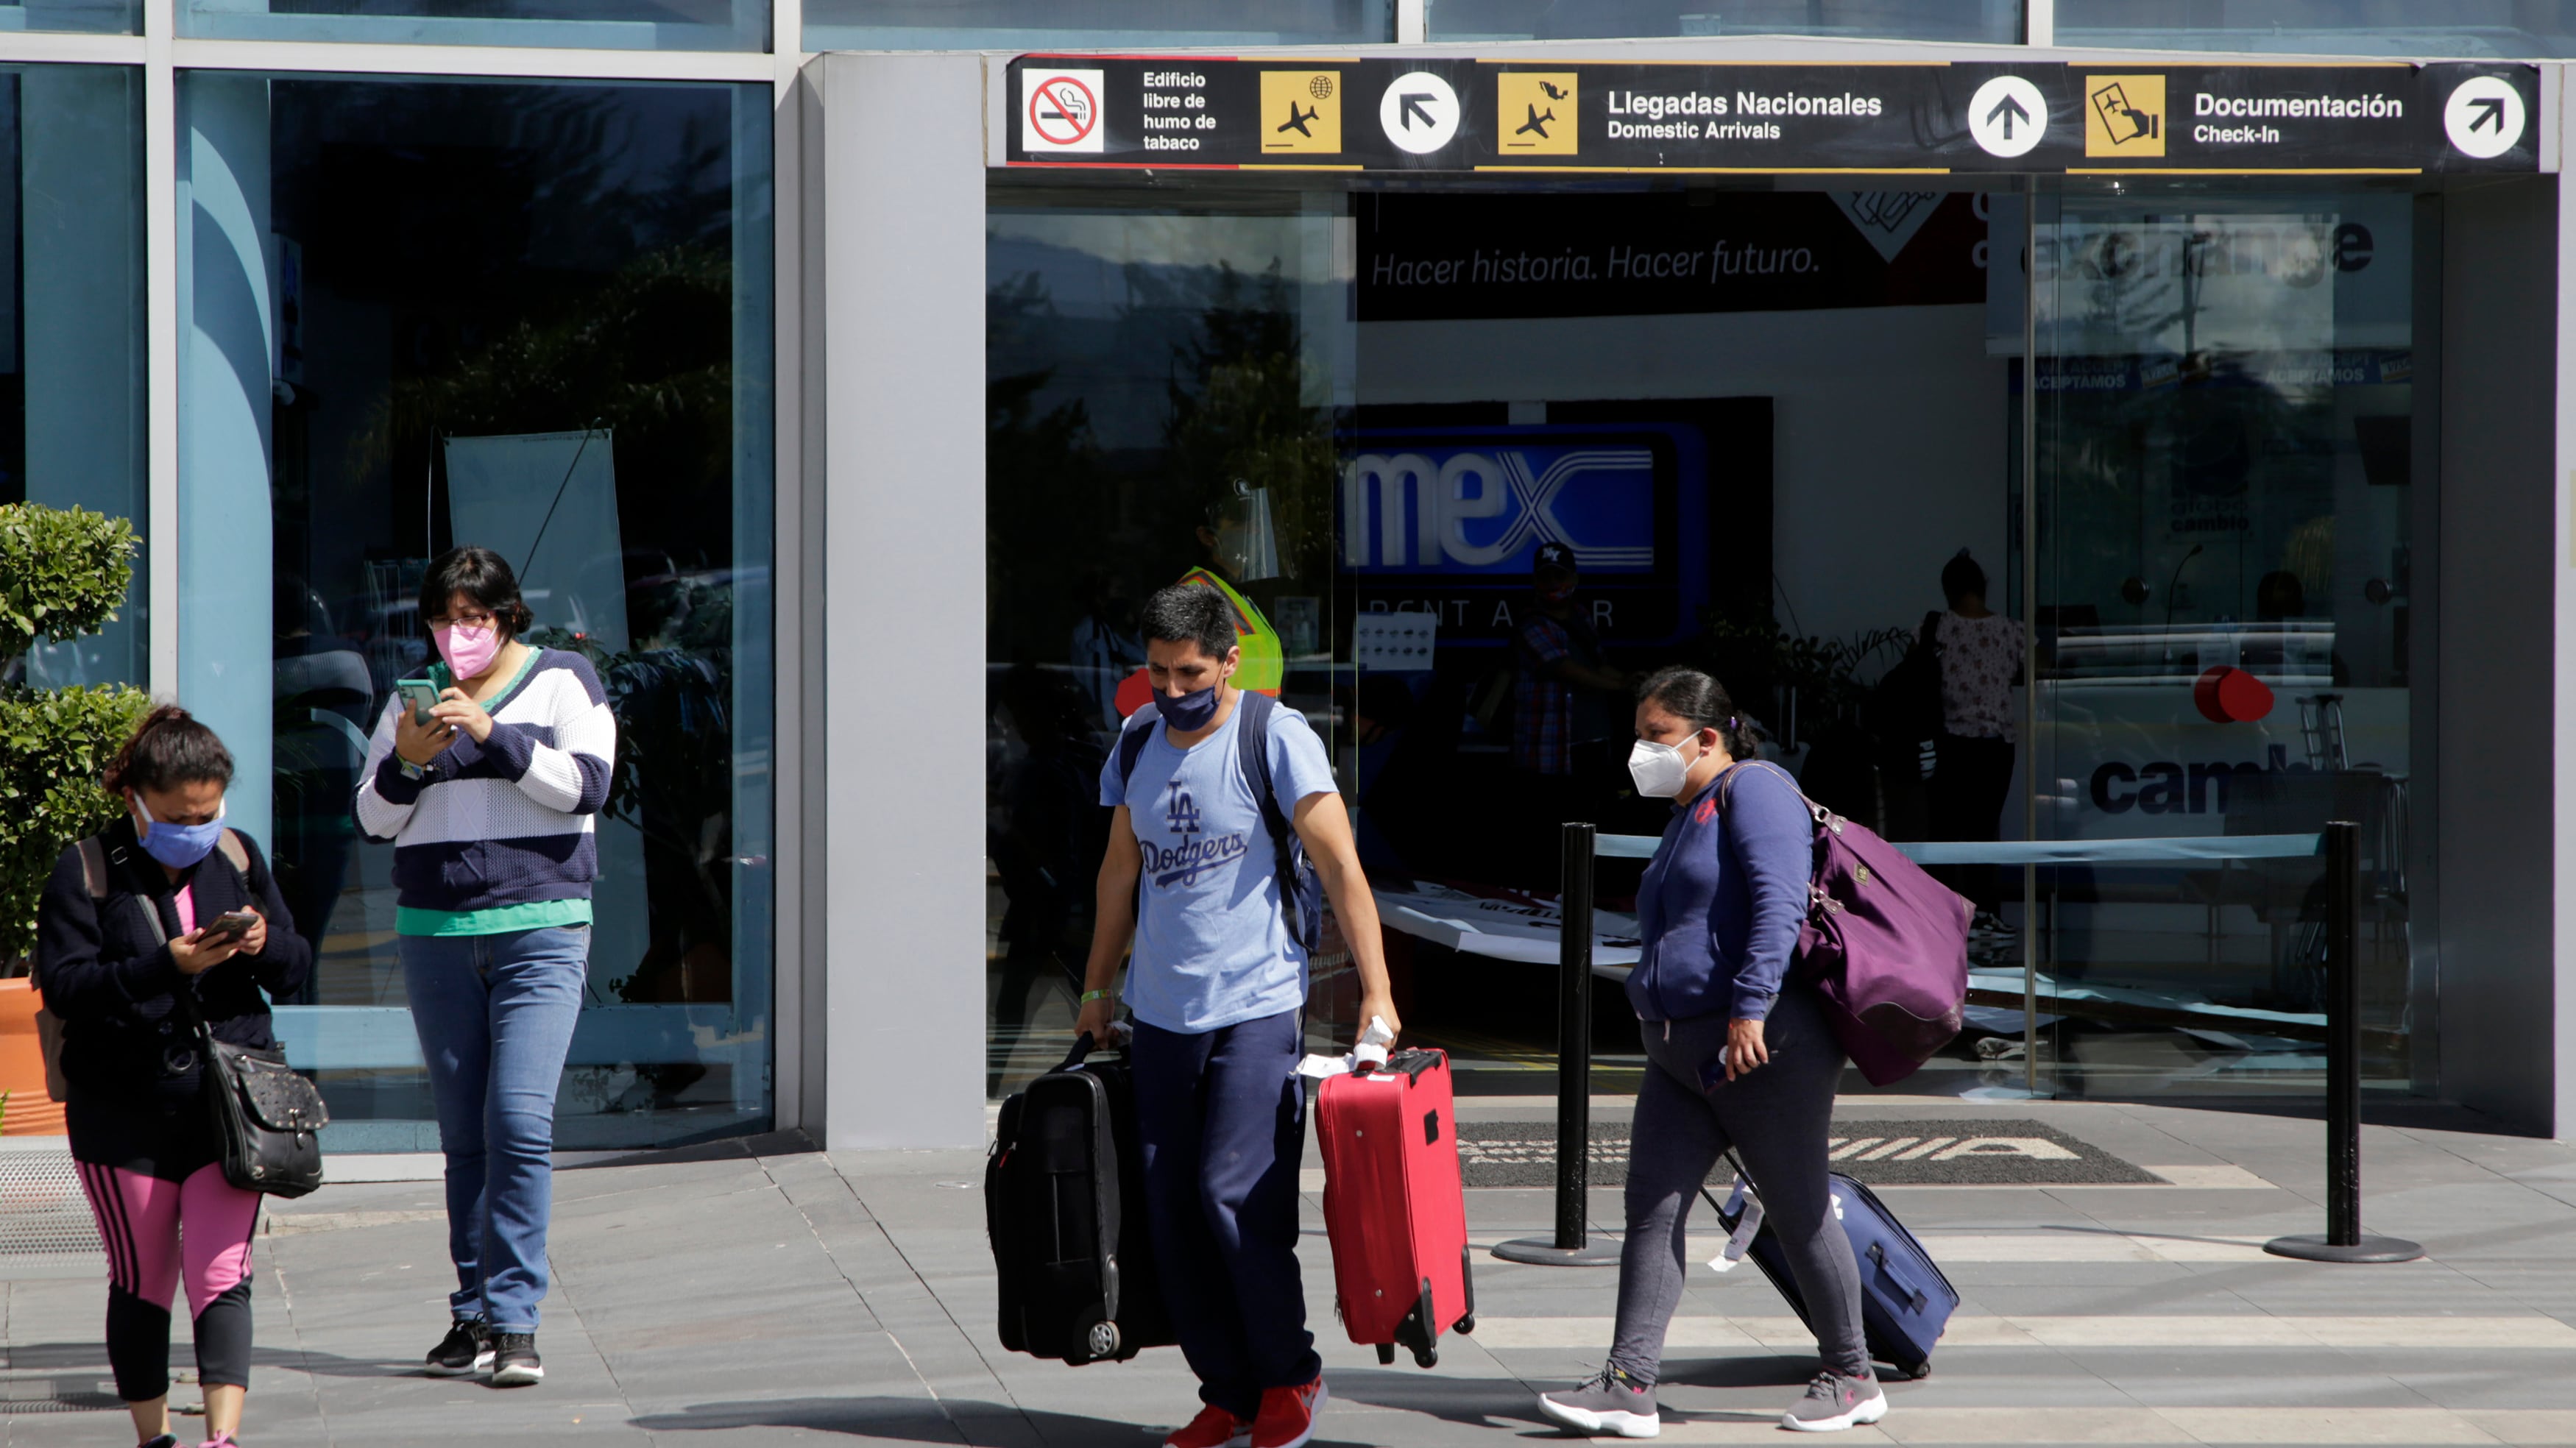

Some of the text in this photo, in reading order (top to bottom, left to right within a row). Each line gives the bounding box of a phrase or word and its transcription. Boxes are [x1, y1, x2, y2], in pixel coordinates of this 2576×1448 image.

[1143, 71, 1206, 88] Edificio
[1143, 93, 1206, 109] libre de
[1608, 90, 1882, 121] Llegadas Nacionales
[2194, 93, 2403, 118] Documentación
[1143, 114, 1217, 129] humo de
[1608, 121, 1781, 140] Domestic Arrivals
[1143, 135, 1200, 150] tabaco
[2193, 124, 2280, 143] Check-In
[1373, 239, 1821, 286] Hacer historia. Hacer futuro.
[2170, 514, 2250, 532] cambio
[1490, 600, 1512, 628] A
[1166, 781, 1200, 833] LA
[1140, 833, 1248, 888] Dodgers
